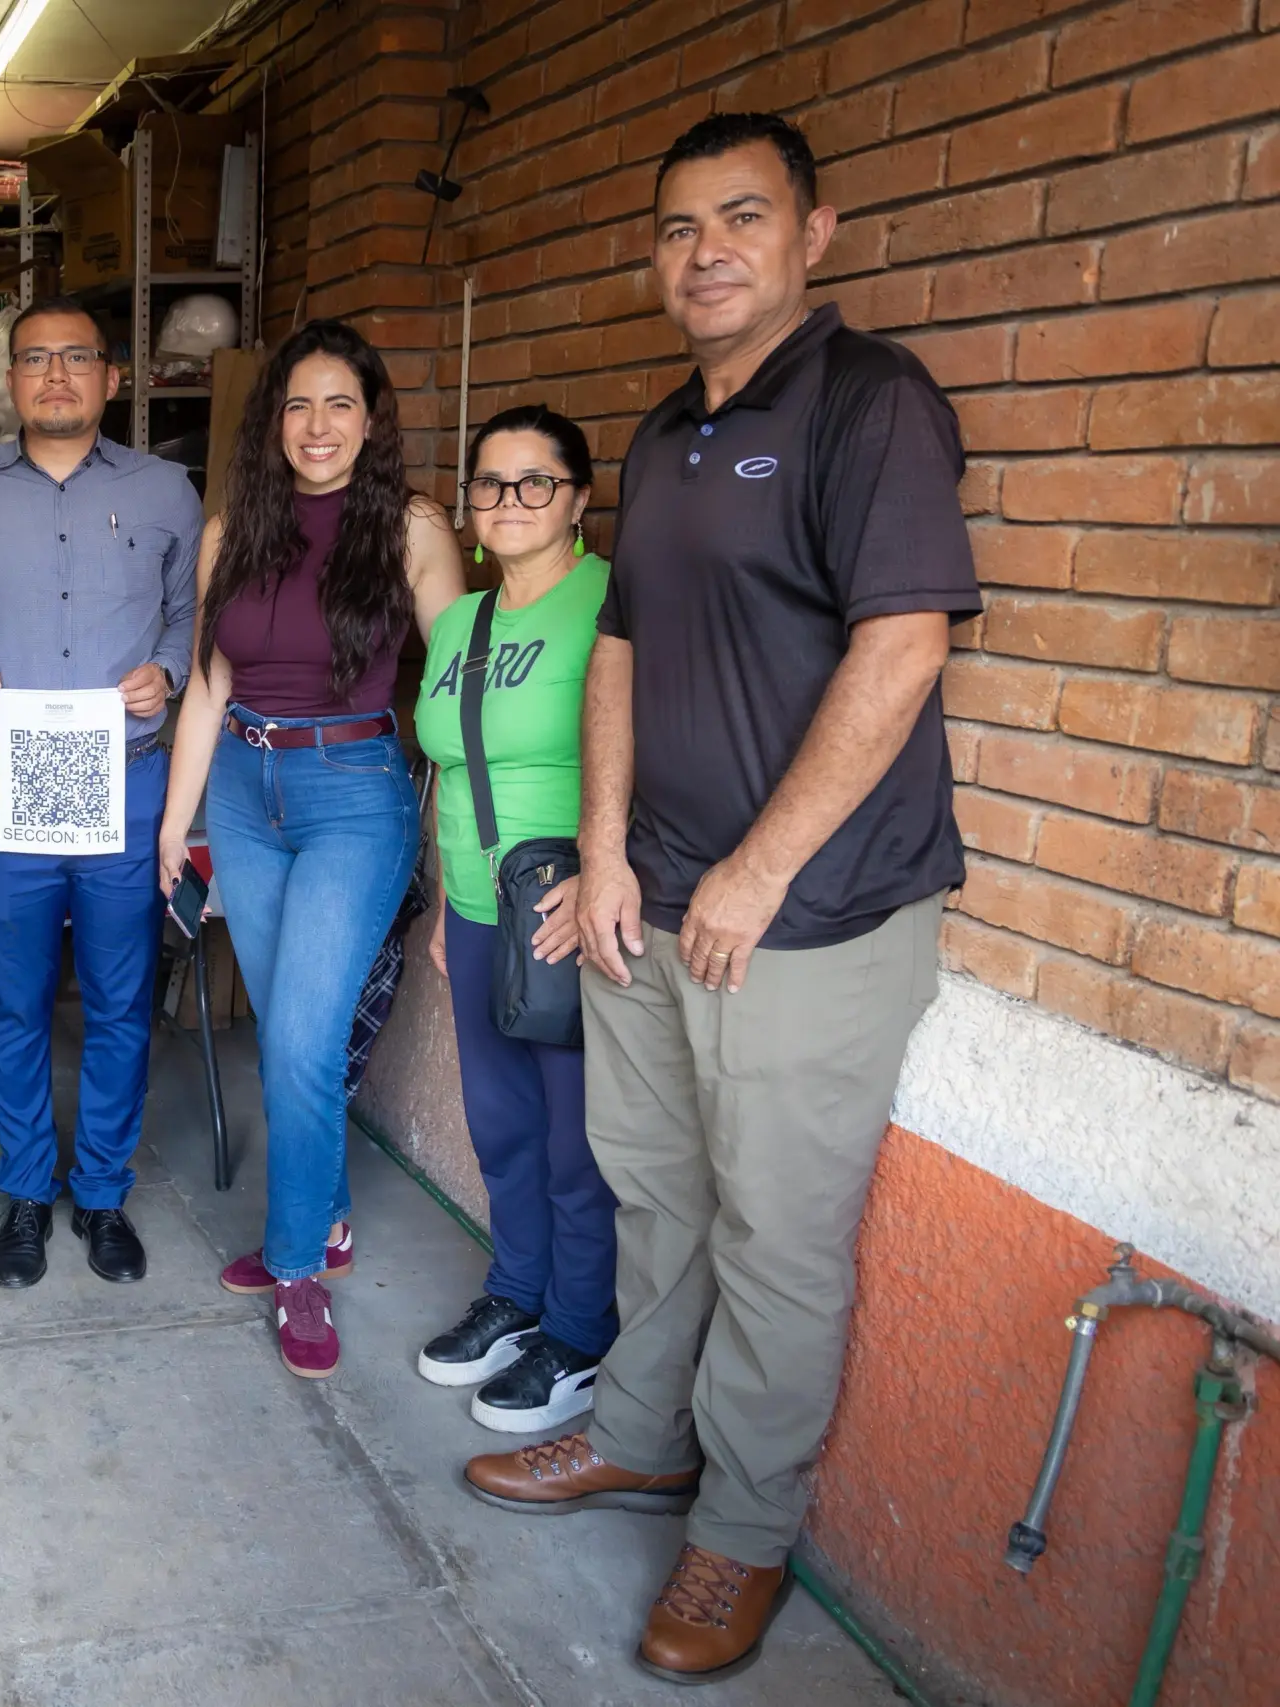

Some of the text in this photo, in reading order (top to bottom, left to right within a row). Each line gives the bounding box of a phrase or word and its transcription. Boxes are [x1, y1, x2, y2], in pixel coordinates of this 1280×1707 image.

[428, 639, 546, 699] ARO
[3, 827, 119, 845] SECCION: 1164
